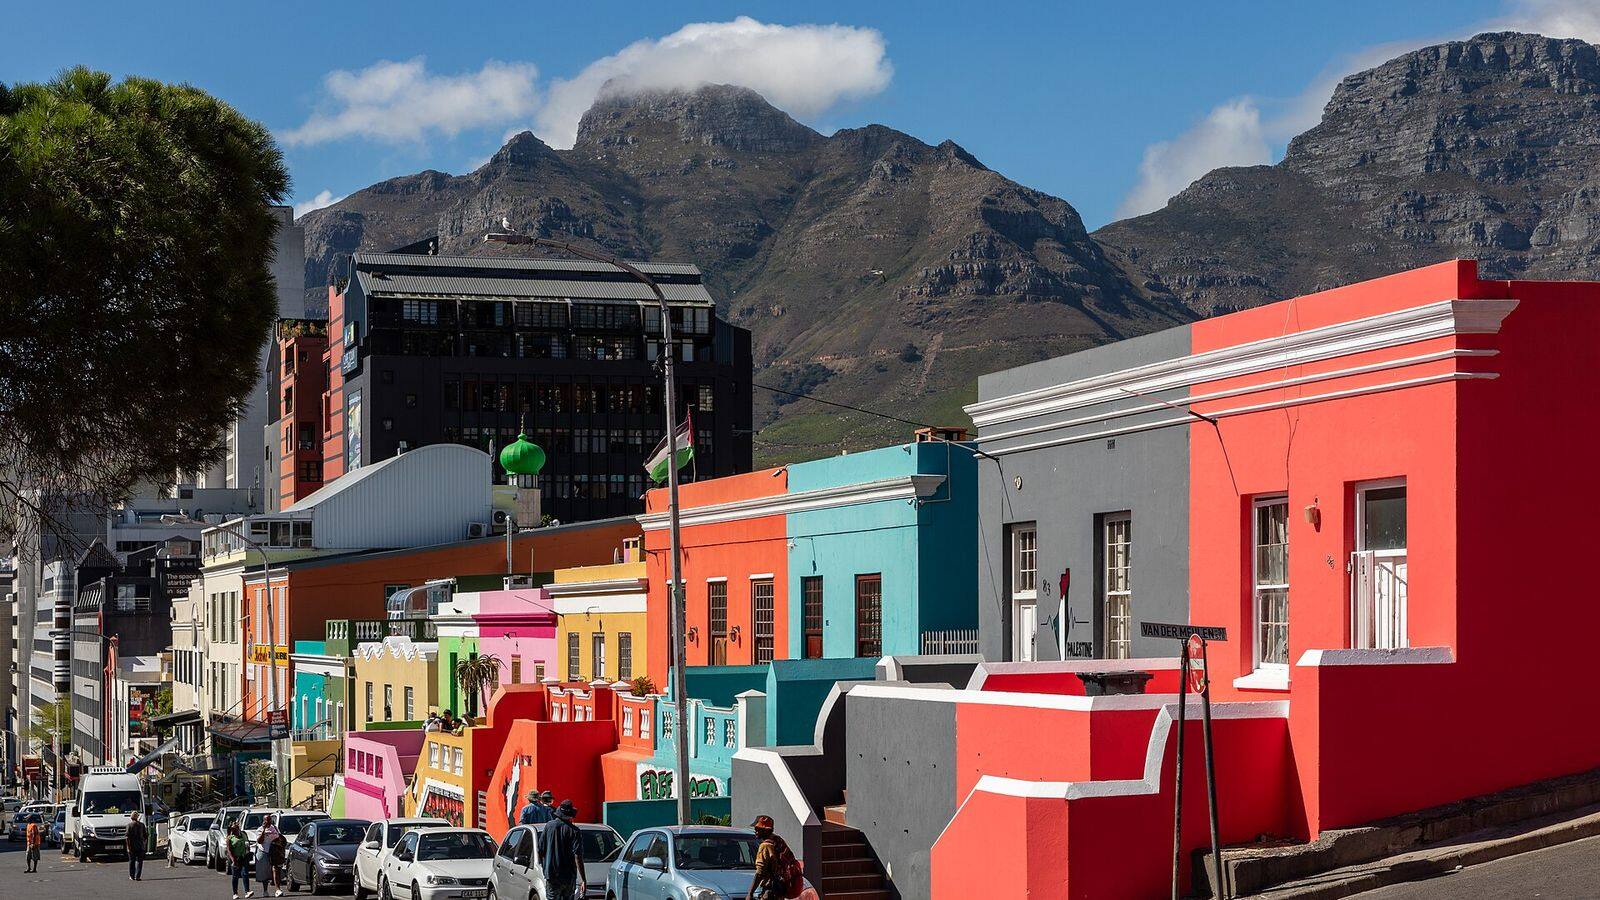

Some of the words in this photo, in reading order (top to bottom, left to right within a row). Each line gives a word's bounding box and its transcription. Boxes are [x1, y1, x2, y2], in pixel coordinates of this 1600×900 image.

[1142, 624, 1160, 637] VAN
[1160, 625, 1178, 638] DER
[1067, 641, 1093, 657] PALESTINE
[640, 769, 674, 800] FREE
[689, 777, 719, 798] AZA
